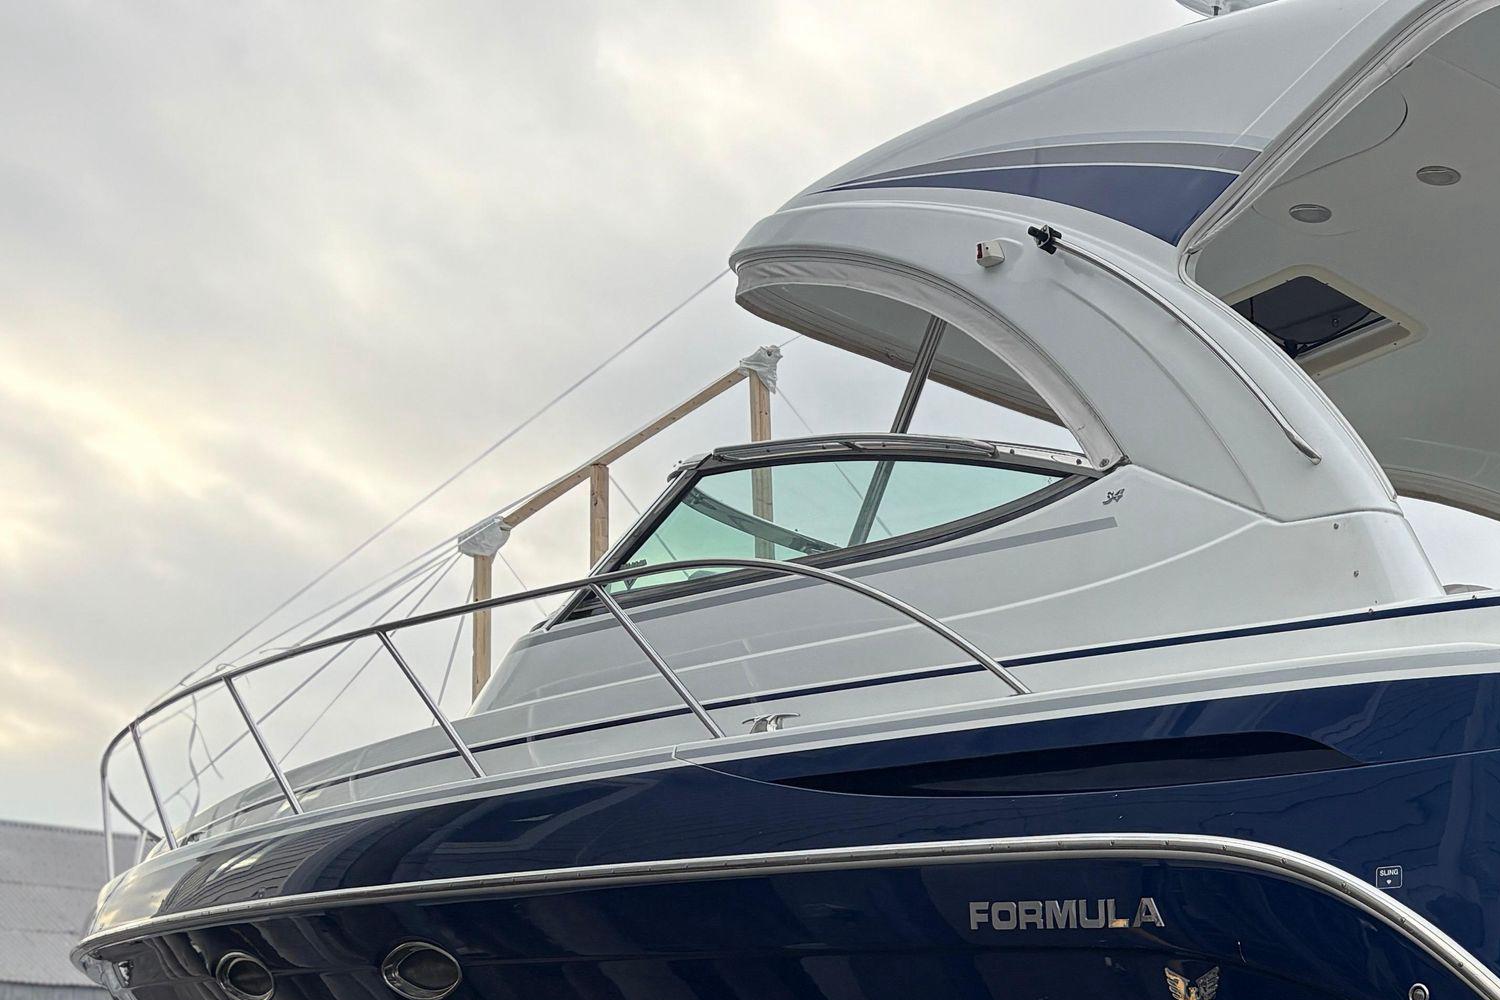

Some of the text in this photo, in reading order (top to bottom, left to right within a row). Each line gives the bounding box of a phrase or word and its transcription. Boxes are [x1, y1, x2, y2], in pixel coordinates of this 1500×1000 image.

[1102, 488, 1125, 505] 34
[1379, 869, 1399, 877] SLING
[969, 897, 1165, 930] FORMULA
